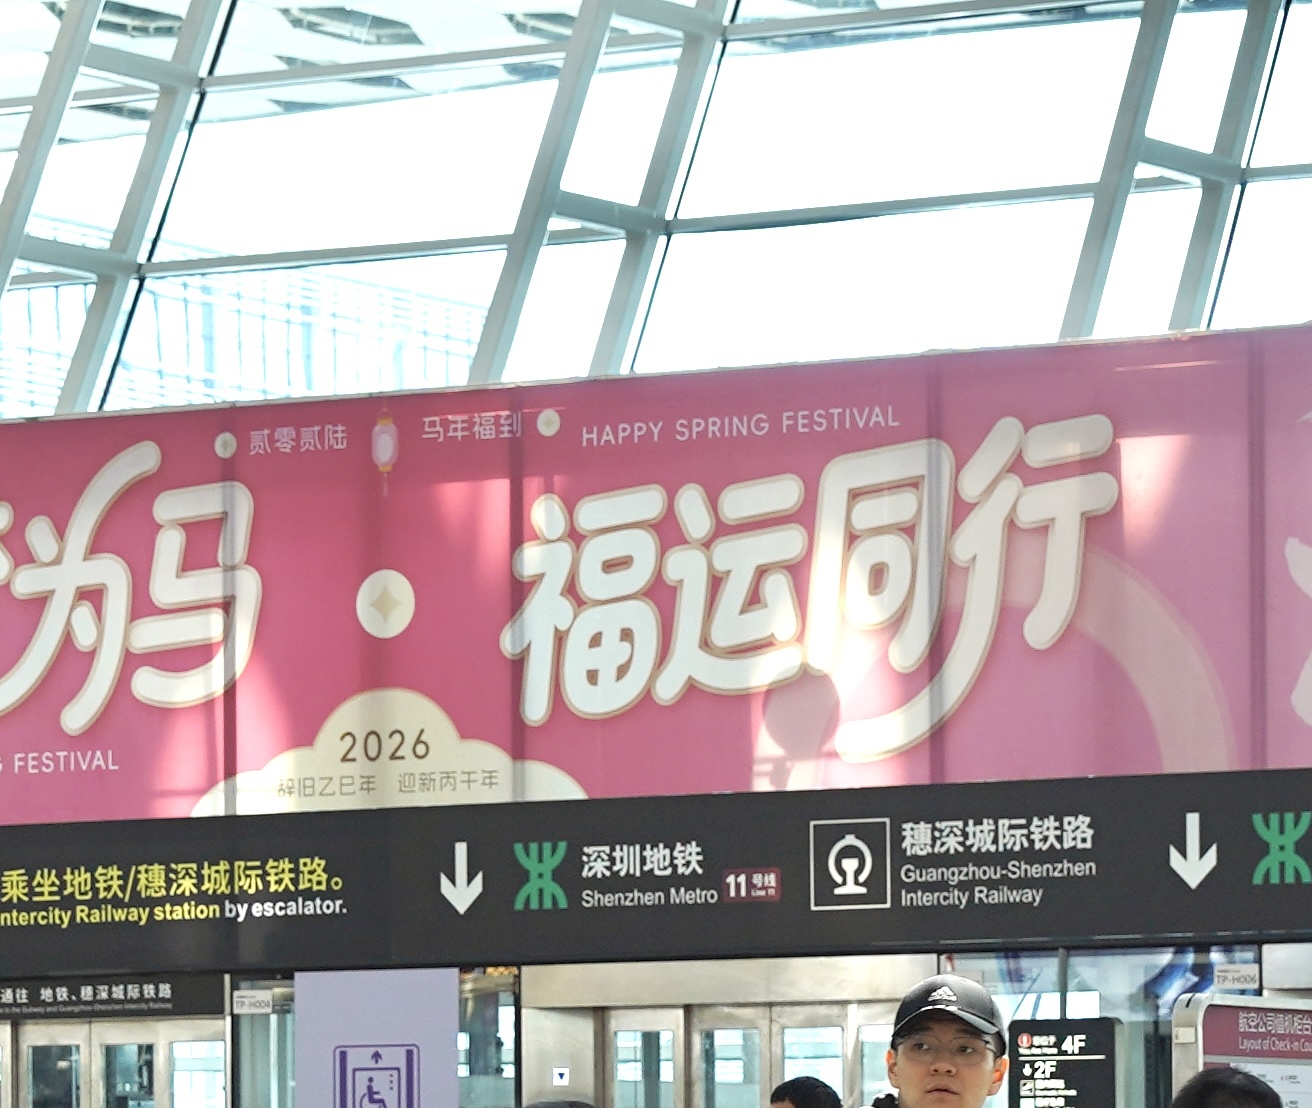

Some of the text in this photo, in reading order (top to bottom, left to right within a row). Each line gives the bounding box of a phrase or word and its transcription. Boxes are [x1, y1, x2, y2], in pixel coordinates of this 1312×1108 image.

[249, 423, 348, 455] 贰零贰陆
[421, 411, 522, 443] 马年福到
[582, 404, 901, 448] HAPPY SPRING FESTIVAL
[499, 413, 1120, 765] 福运同行
[339, 728, 430, 763] 2026
[13, 748, 120, 775] FESTIVAL
[277, 773, 377, 798] 辞旧乙巳年
[900, 814, 1095, 857] 穗深城际铁路
[581, 840, 705, 879] 深圳地铁
[900, 859, 1097, 885] Guangzhou-Shenzhen
[581, 887, 719, 908] Shenzhen Metro
[725, 872, 778, 898] 11 号线
[901, 885, 1044, 909] Intercity Railway
[76, 904, 150, 926] Railway
[153, 902, 220, 921] station
[224, 899, 250, 923] by
[251, 898, 348, 918] escalator.
[1061, 1034, 1086, 1055] 4F
[1239, 1037, 1261, 1052] Layout
[1262, 1037, 1270, 1049] of
[1270, 1038, 1299, 1051] Check-in
[1033, 1060, 1057, 1078] 2F
